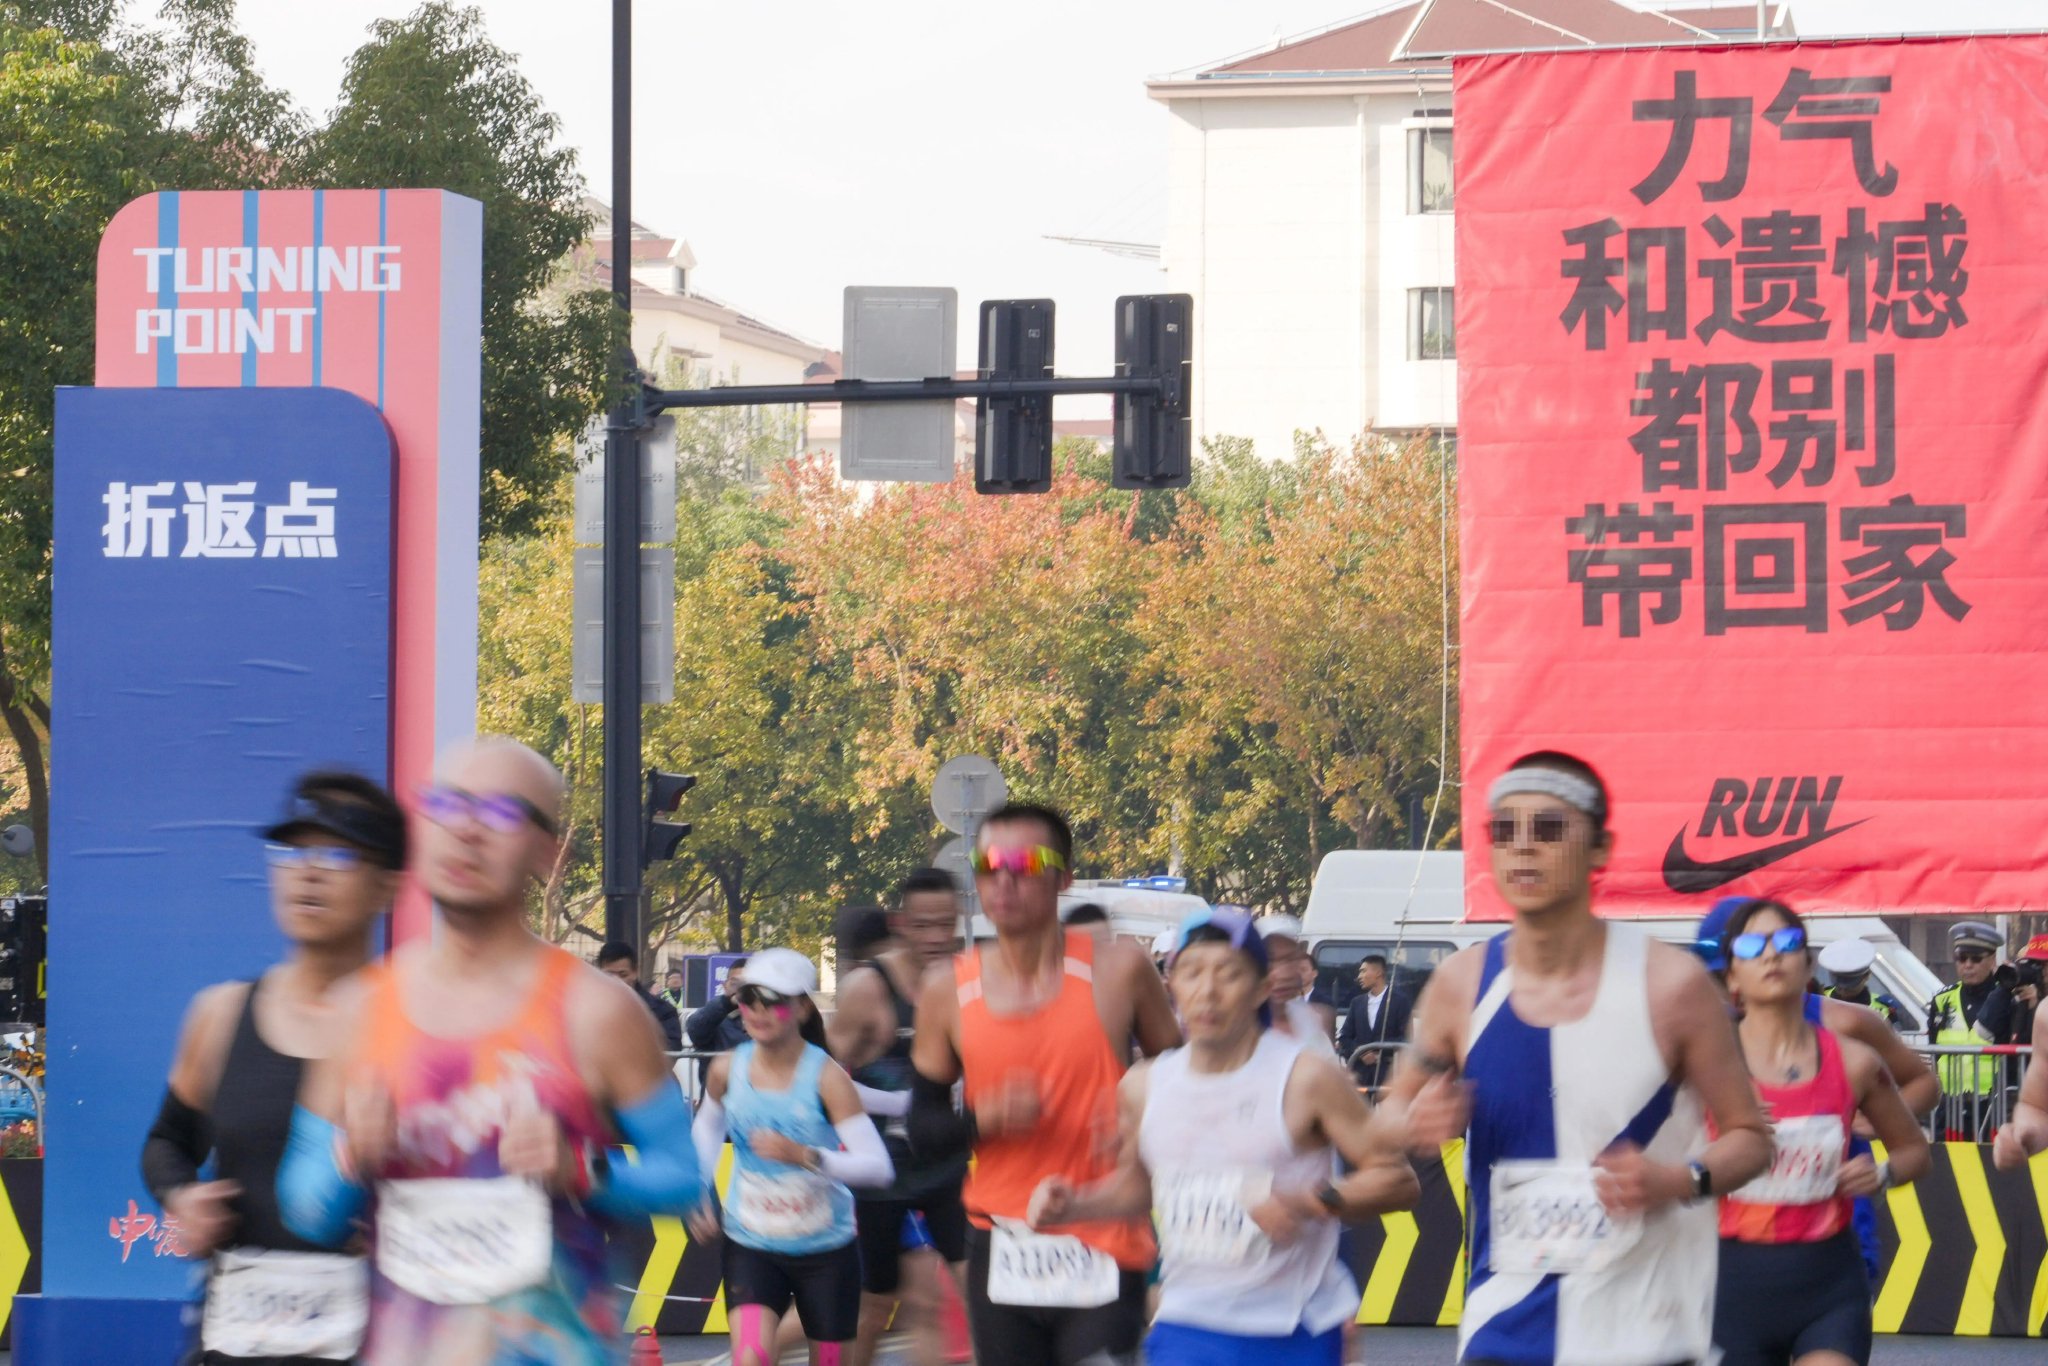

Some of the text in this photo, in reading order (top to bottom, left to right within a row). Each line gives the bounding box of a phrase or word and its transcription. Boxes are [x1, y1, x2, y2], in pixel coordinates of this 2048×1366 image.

[1630, 67, 1898, 205] 力气
[133, 245, 402, 294] TURNING
[1559, 202, 1970, 350] 和遗憾
[135, 307, 317, 354] POINT
[1628, 353, 1897, 493] 都别
[101, 481, 338, 558] 折返点
[1565, 494, 1972, 638] 带回家
[1696, 776, 1844, 838] RUN
